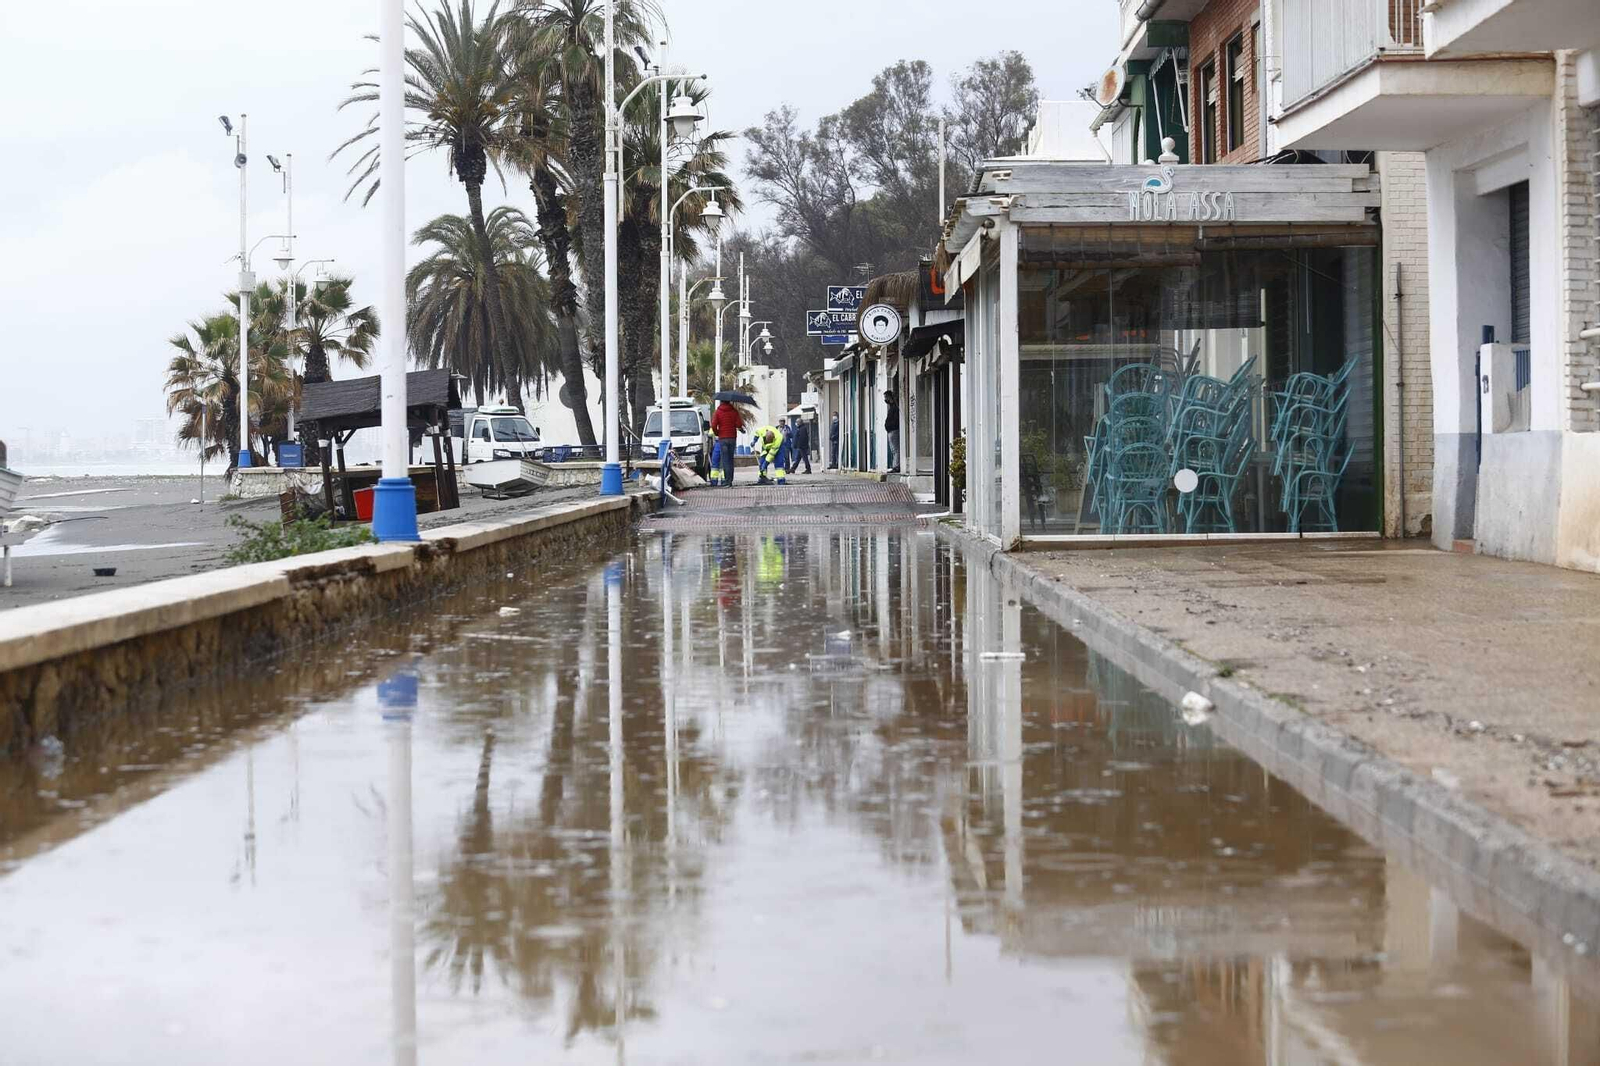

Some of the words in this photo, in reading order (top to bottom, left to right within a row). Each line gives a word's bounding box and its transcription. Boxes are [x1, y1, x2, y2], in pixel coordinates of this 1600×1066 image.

[1128, 191, 1177, 221] NOLA
[1188, 191, 1235, 221] ASSA
[855, 290, 863, 299] EL
[832, 314, 840, 322] EL
